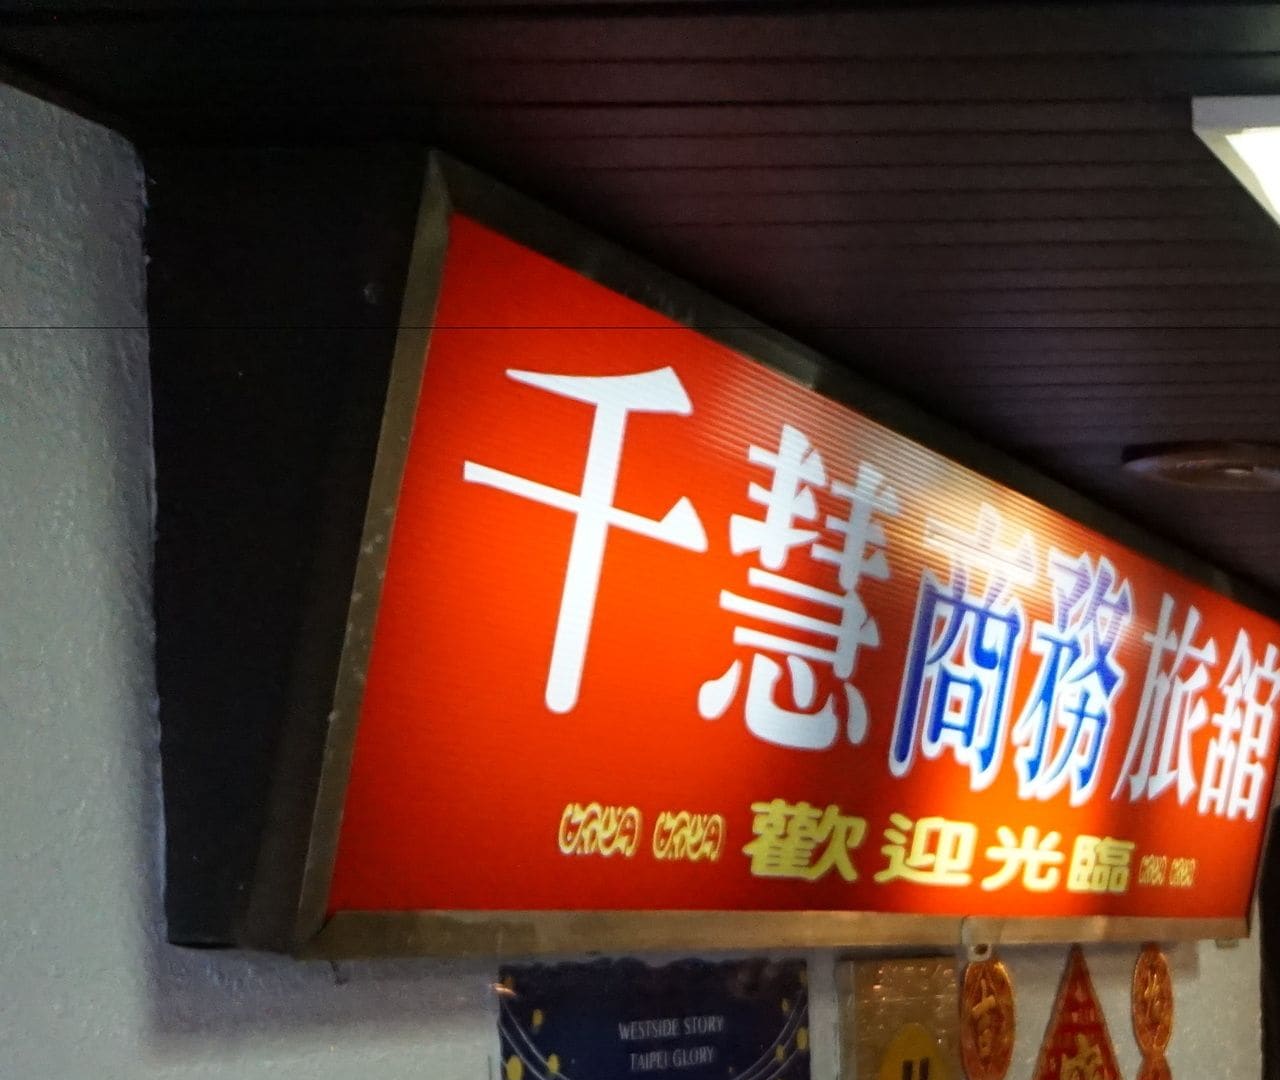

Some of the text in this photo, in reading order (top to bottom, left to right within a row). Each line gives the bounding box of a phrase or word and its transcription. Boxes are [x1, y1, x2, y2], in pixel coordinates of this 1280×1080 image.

[743, 799, 1136, 893] 歡迎光臨
[618, 1015, 725, 1040] WESTSIDE STORY
[630, 1046, 715, 1072] TAIPEI GLORY
